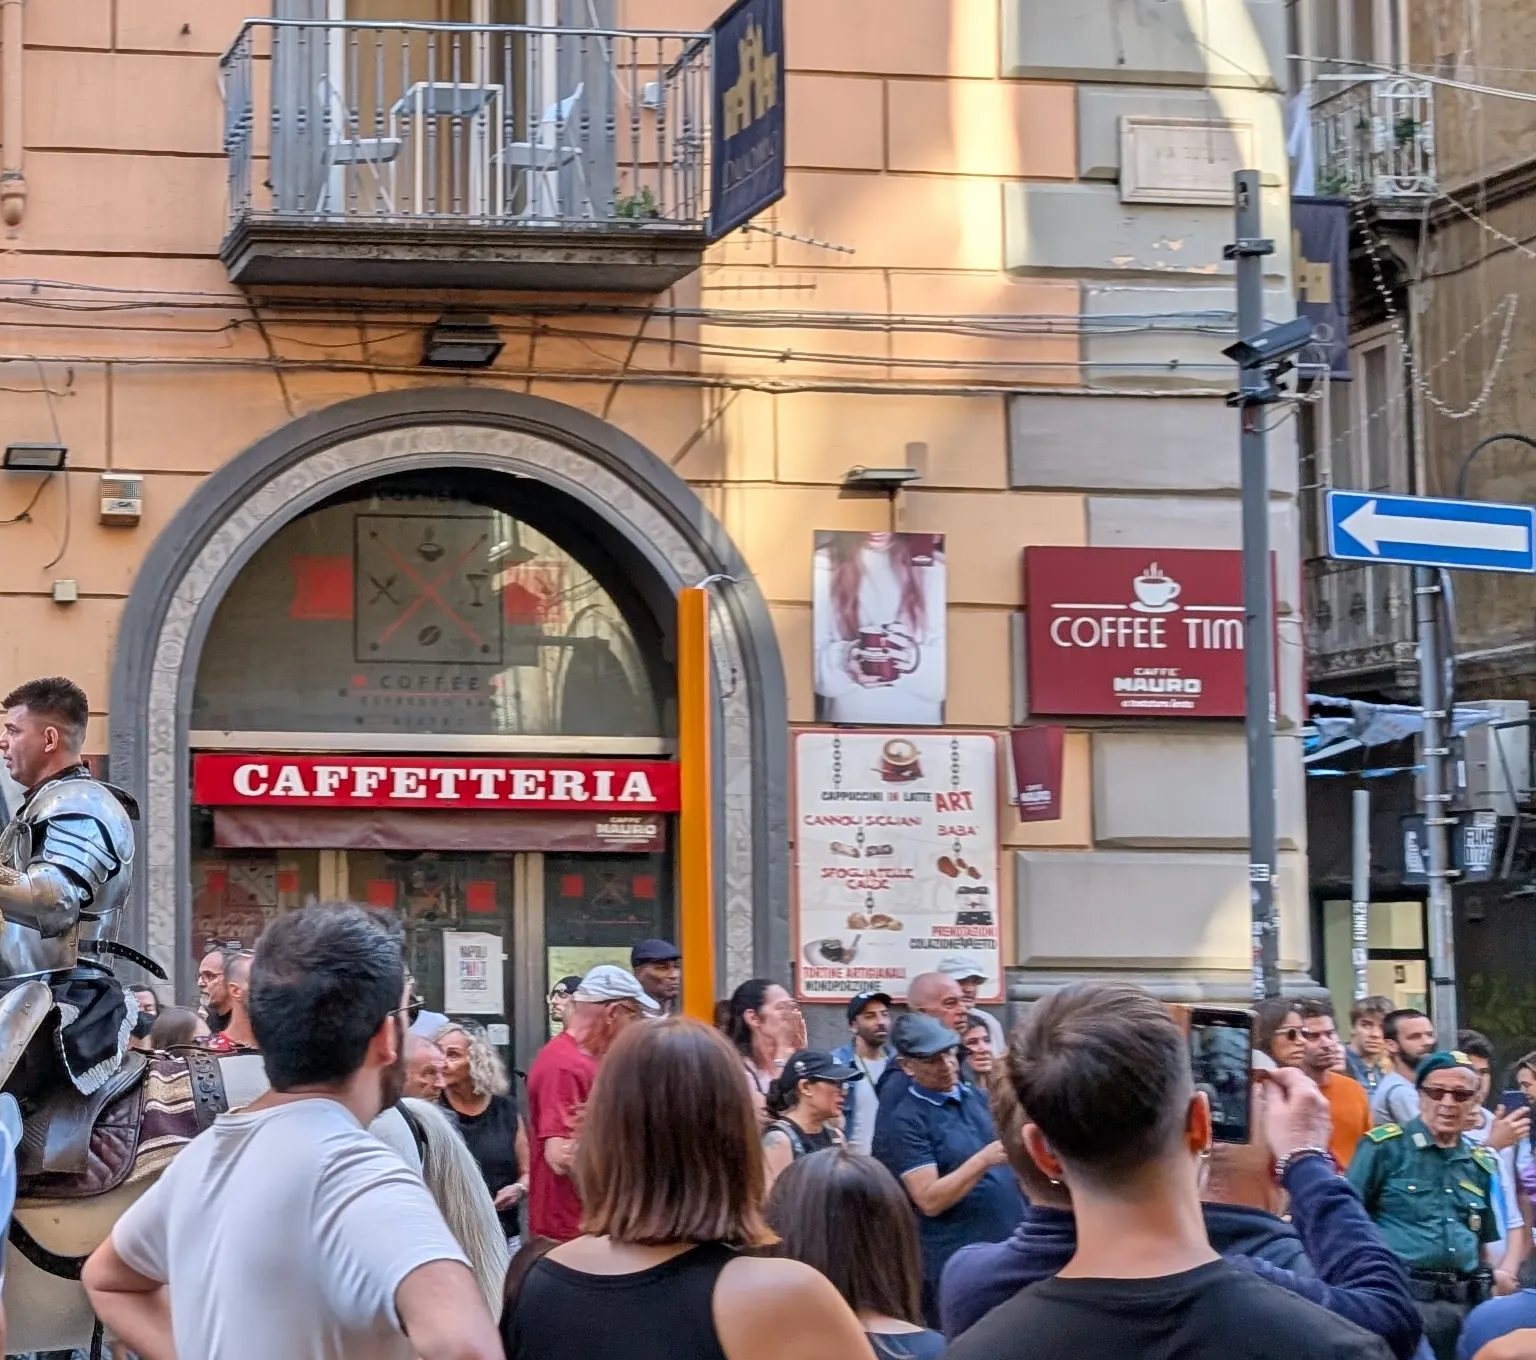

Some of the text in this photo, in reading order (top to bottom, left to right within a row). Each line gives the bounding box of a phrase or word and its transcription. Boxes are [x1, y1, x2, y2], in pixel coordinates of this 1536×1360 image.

[1050, 616, 1245, 650] COFFEE TIM
[380, 675, 479, 690] COFFEE
[1113, 677, 1202, 693] MAURO
[232, 763, 657, 803] CAFFETTERIA
[936, 791, 974, 812] ART
[804, 814, 862, 826] CANNOLI
